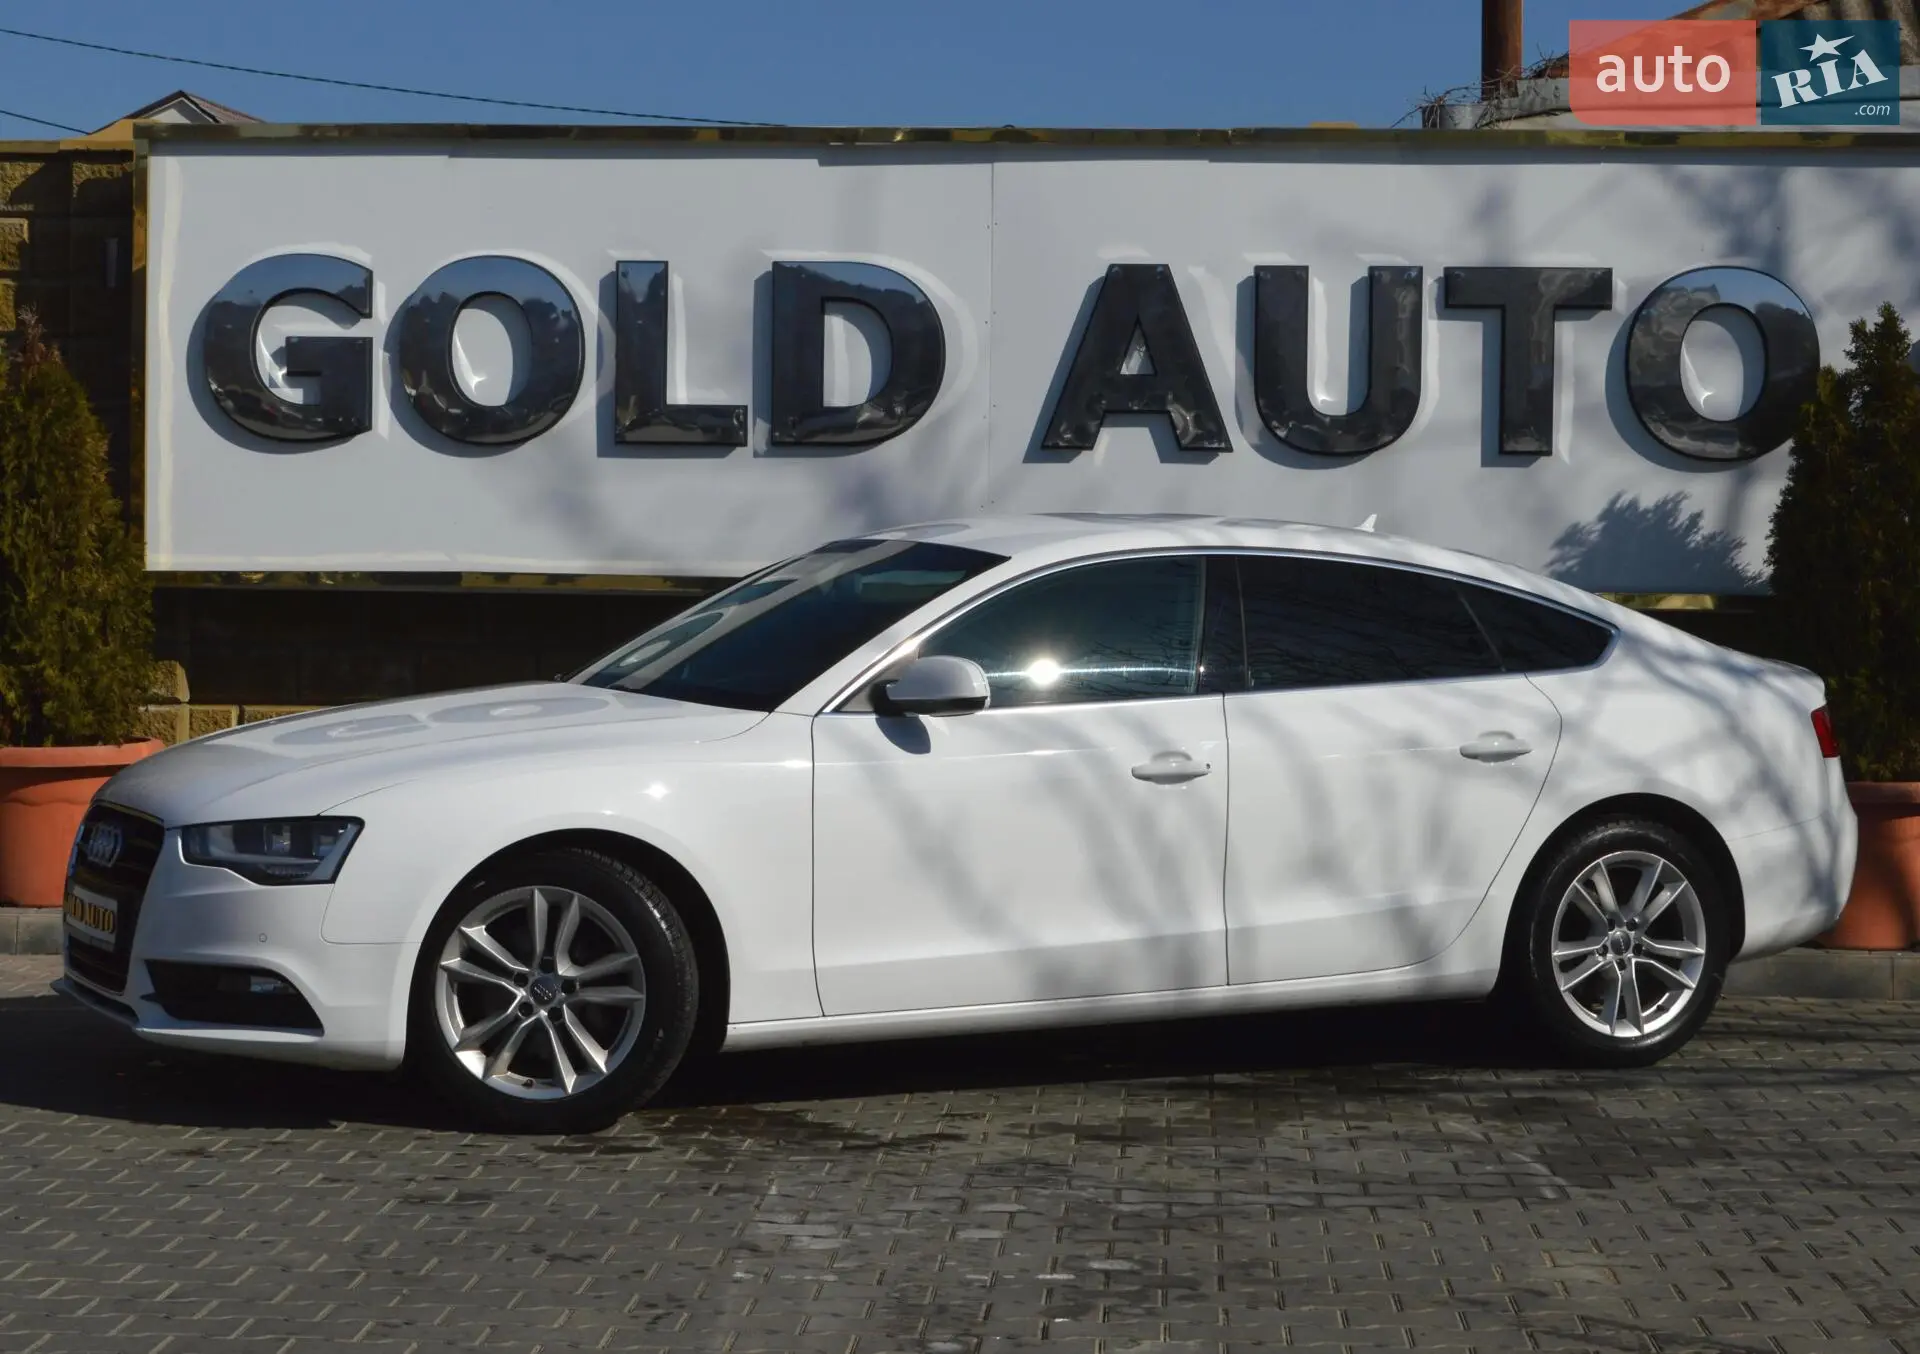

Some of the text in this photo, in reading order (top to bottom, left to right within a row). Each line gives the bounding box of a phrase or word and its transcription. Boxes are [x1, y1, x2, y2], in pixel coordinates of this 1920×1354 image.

[204, 253, 1821, 462] GOLD AUTO
[85, 902, 116, 933] AUTO
